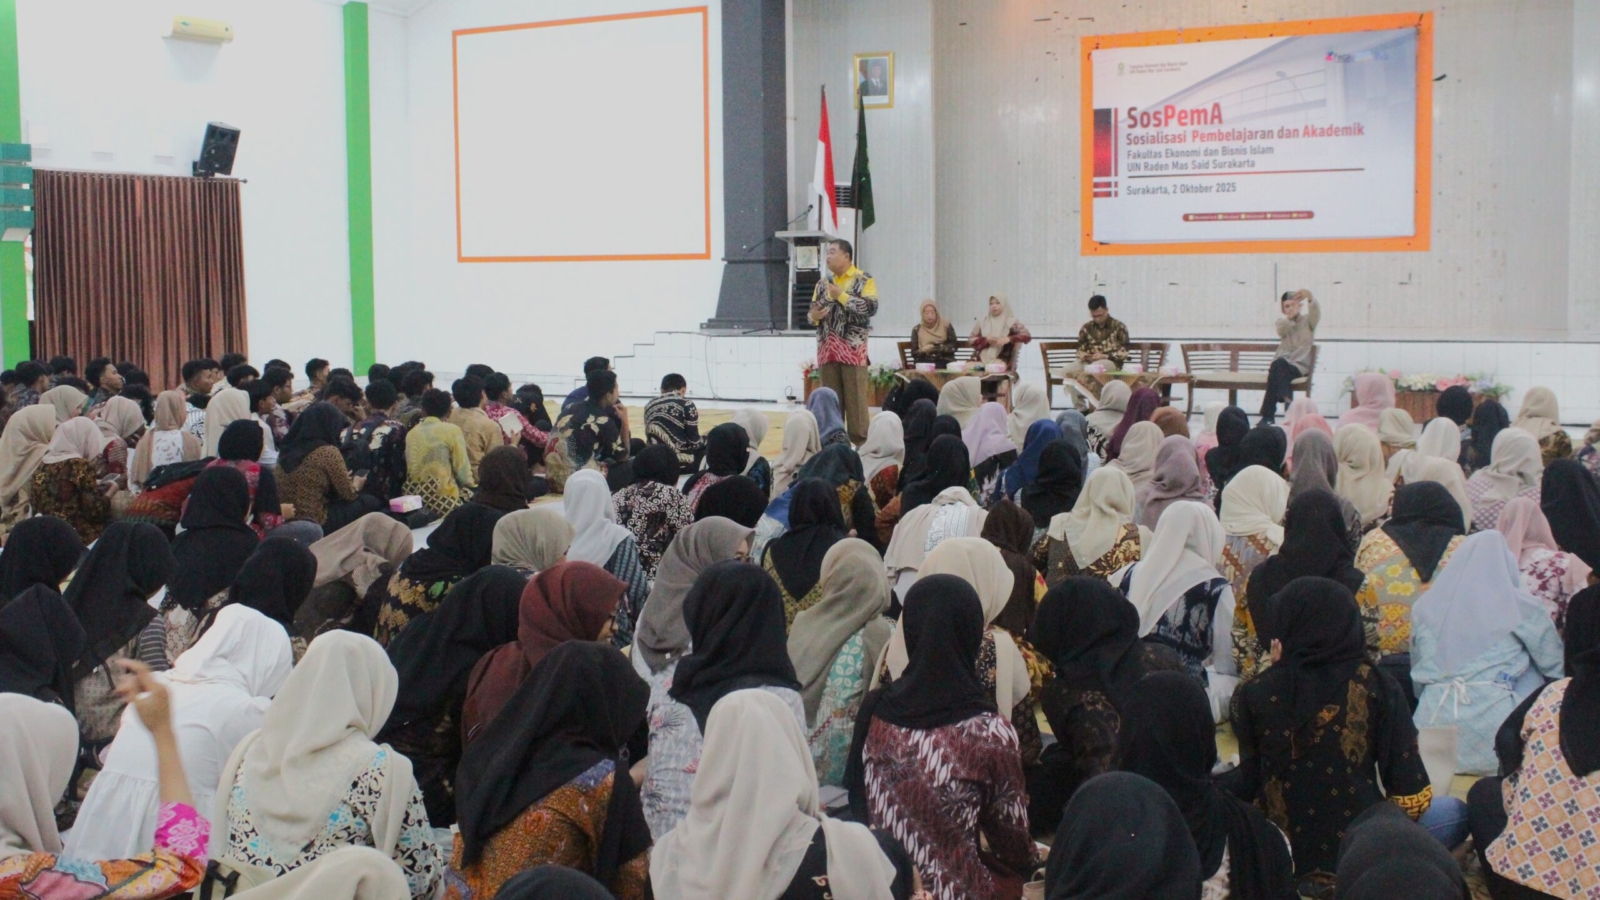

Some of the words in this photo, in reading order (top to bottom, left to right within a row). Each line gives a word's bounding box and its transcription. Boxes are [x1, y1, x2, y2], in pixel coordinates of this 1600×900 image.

[1127, 102, 1223, 129] SosPemA
[1126, 130, 1187, 146] Sosialisasi
[1192, 128, 1274, 143] Pembelajaran
[1277, 126, 1299, 139] dan
[1302, 123, 1364, 138] Akademik
[1127, 150, 1162, 160] Fakultas
[1165, 147, 1200, 158] Ekonomi
[1203, 147, 1219, 157] dan
[1221, 145, 1247, 156] Bisnis
[1250, 145, 1274, 155] Islam
[1127, 162, 1141, 172] UIN
[1143, 161, 1169, 171] Raden
[1172, 160, 1188, 170] Mas
[1191, 159, 1210, 170] Said
[1212, 159, 1256, 169] Surakarta
[1126, 185, 1170, 196] Surakarta,
[1172, 184, 1178, 194] 2
[1180, 183, 1213, 194] Oktober
[1215, 182, 1237, 193] 2025
